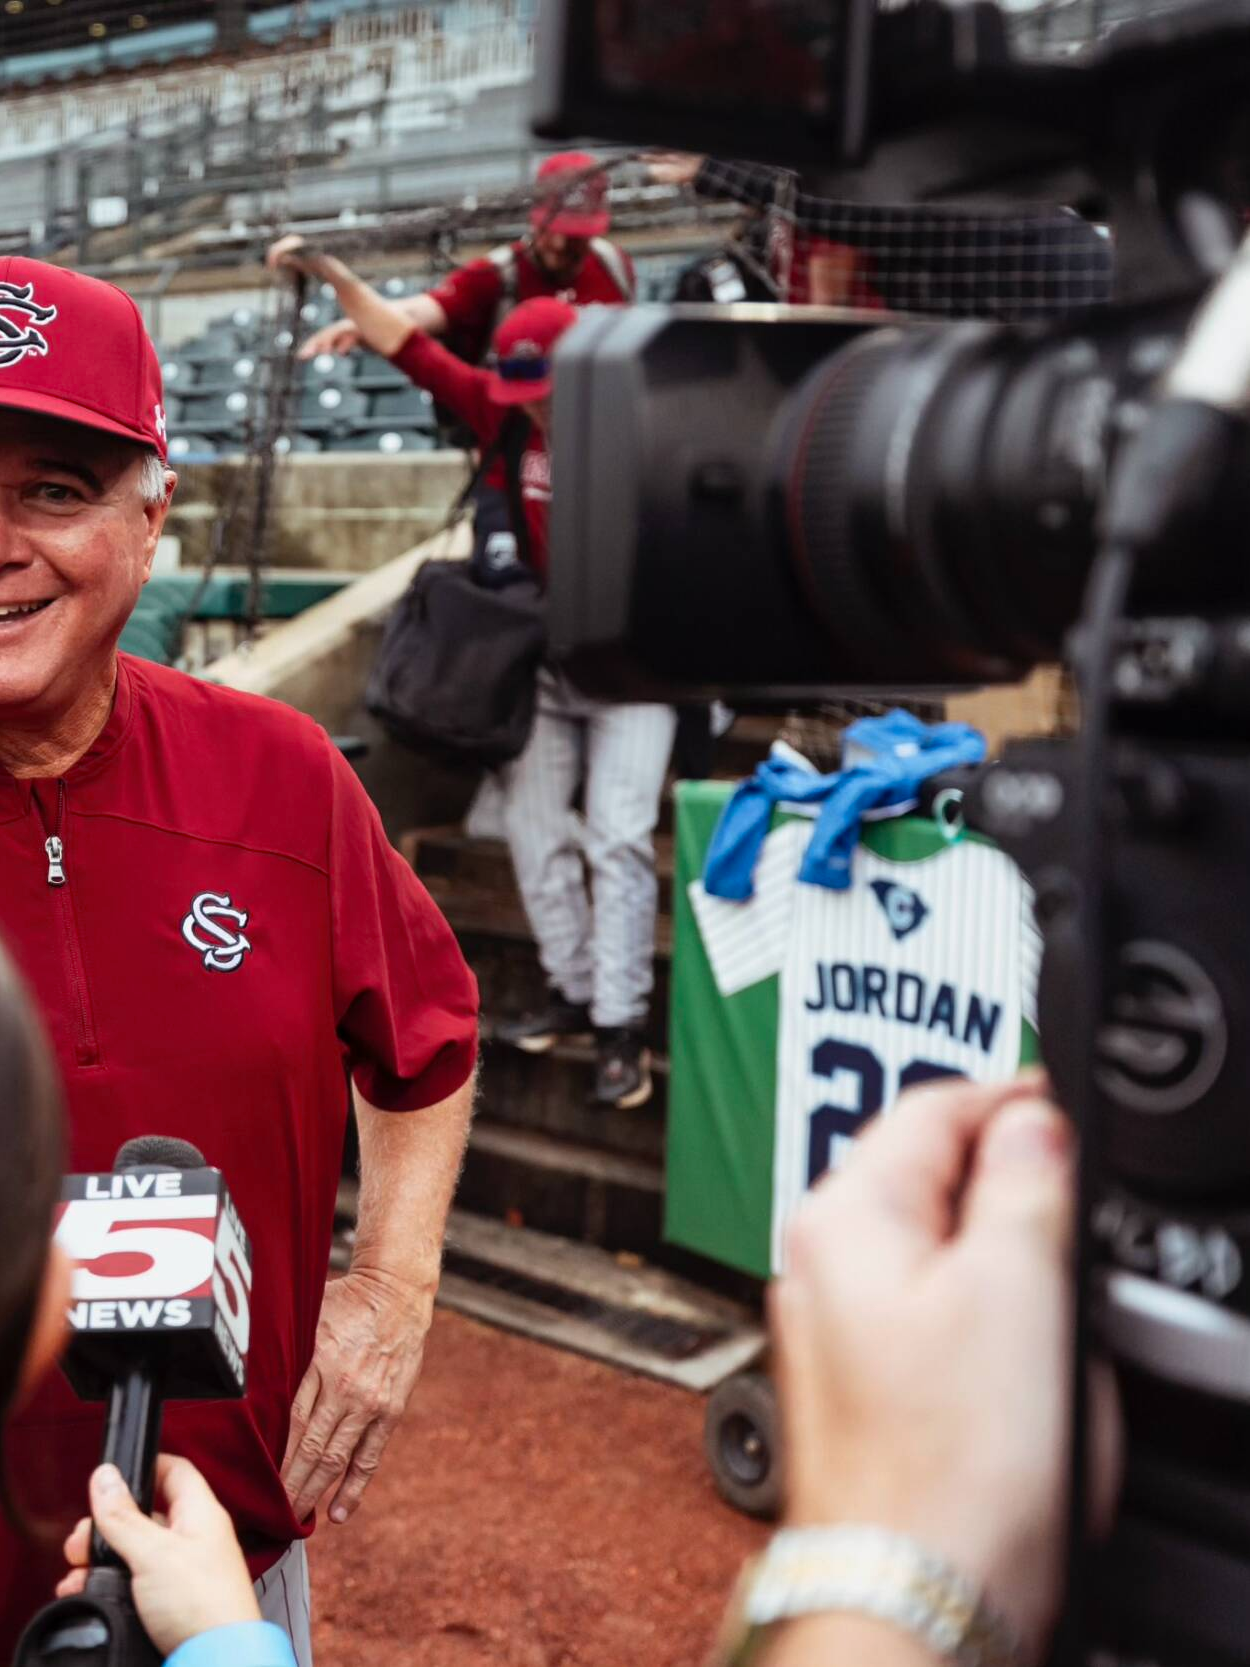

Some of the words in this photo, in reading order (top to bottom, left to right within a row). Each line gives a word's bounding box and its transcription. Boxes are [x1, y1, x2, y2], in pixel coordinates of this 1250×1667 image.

[804, 961, 1003, 1055] JORDAN
[806, 1037, 970, 1190] 2
[85, 1172, 182, 1200] LIVE
[53, 1194, 217, 1300] 5
[212, 1209, 252, 1354] 5
